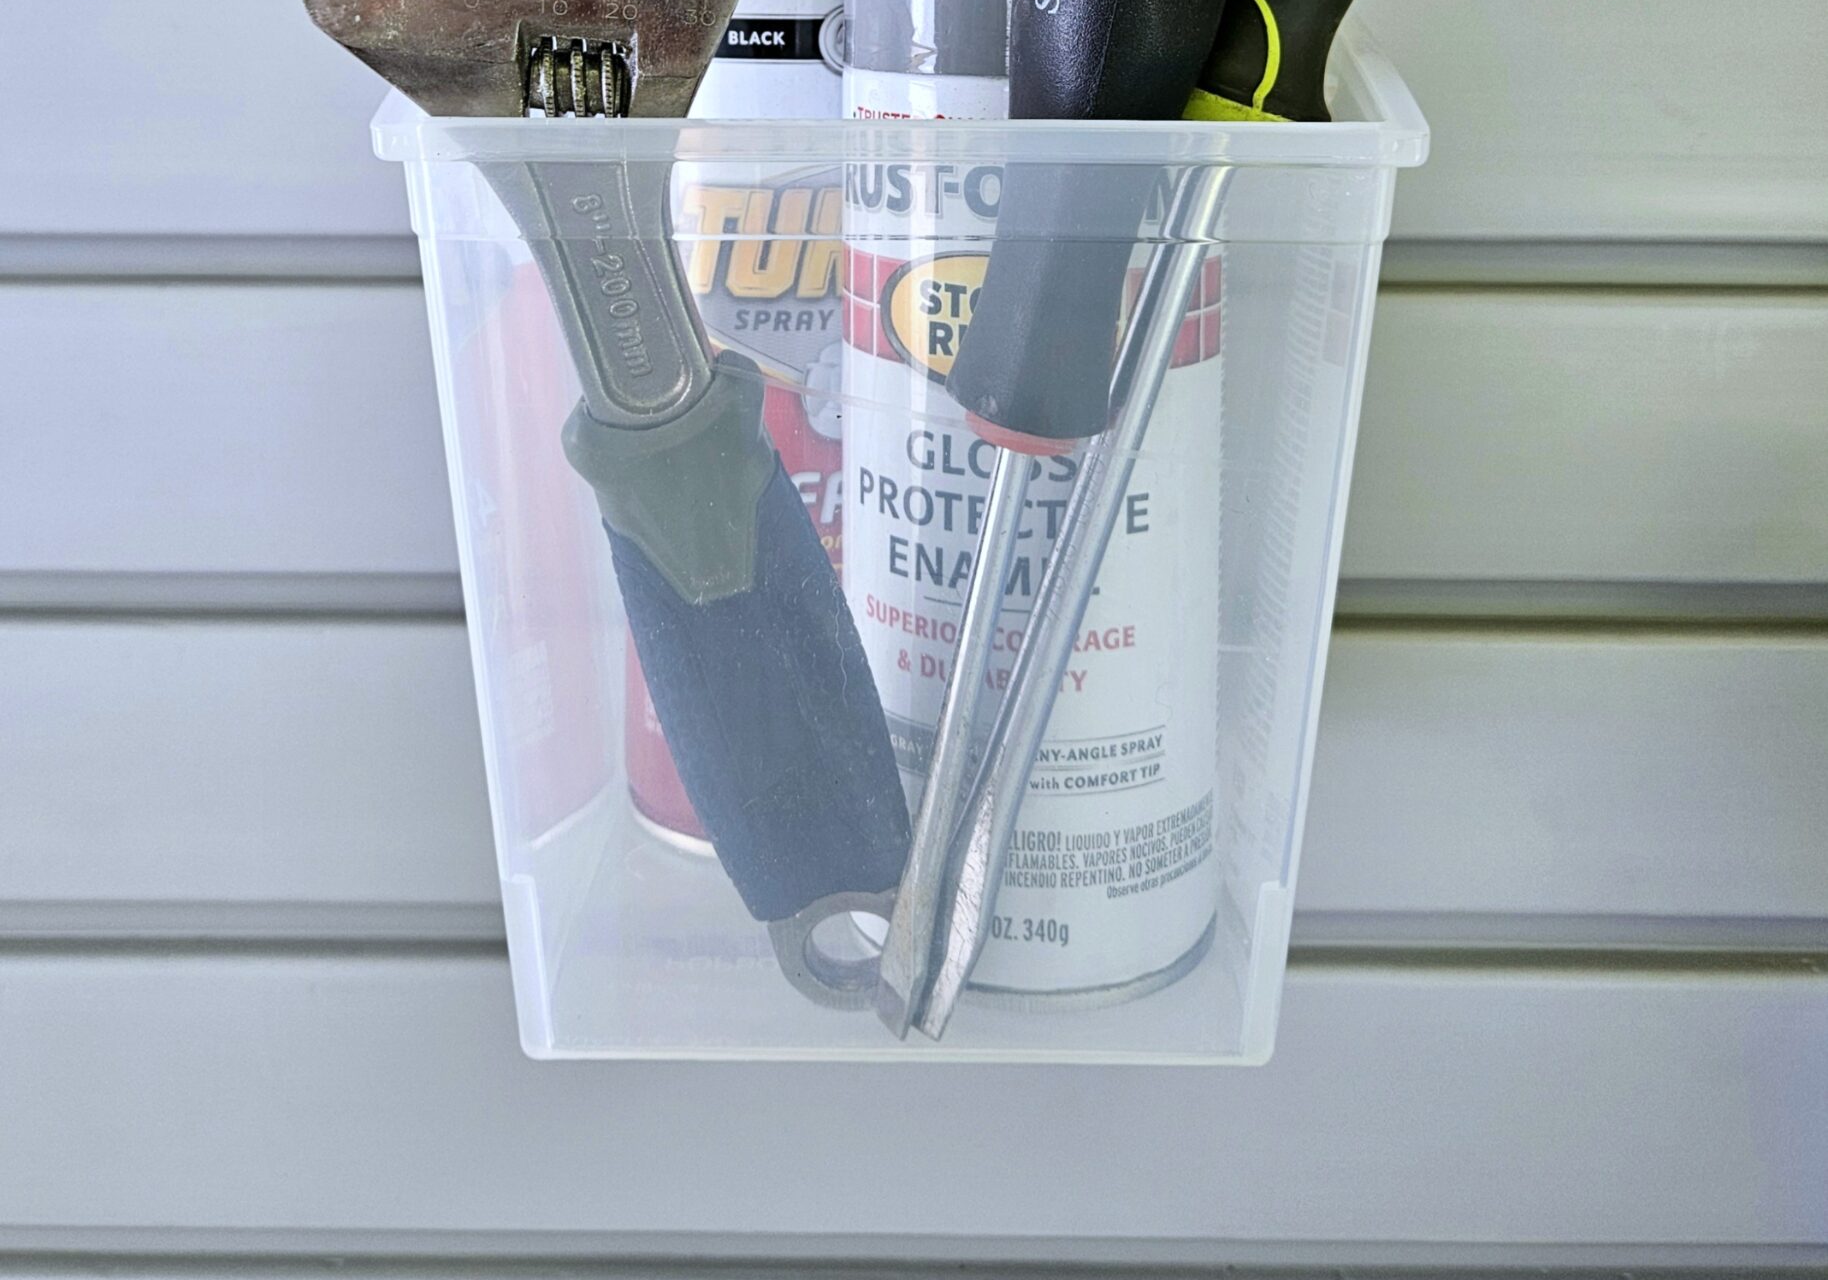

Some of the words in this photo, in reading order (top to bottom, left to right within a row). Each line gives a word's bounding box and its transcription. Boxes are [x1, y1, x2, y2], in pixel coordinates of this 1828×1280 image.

[605, 2, 638, 20] 20
[727, 29, 786, 46] BLACK
[734, 308, 835, 332] SPRAY
[866, 594, 959, 645] SUPERIO
[897, 648, 912, 671] &
[890, 733, 923, 755] GRAY
[1034, 744, 1117, 763] NY-ANGLE
[1120, 733, 1164, 757] SPRAY
[1029, 776, 1060, 791] with
[1064, 767, 1139, 790] COMFORT
[1139, 763, 1161, 780] TIP
[1007, 830, 1061, 852] LIGRO!
[1023, 918, 1070, 948] 340g
